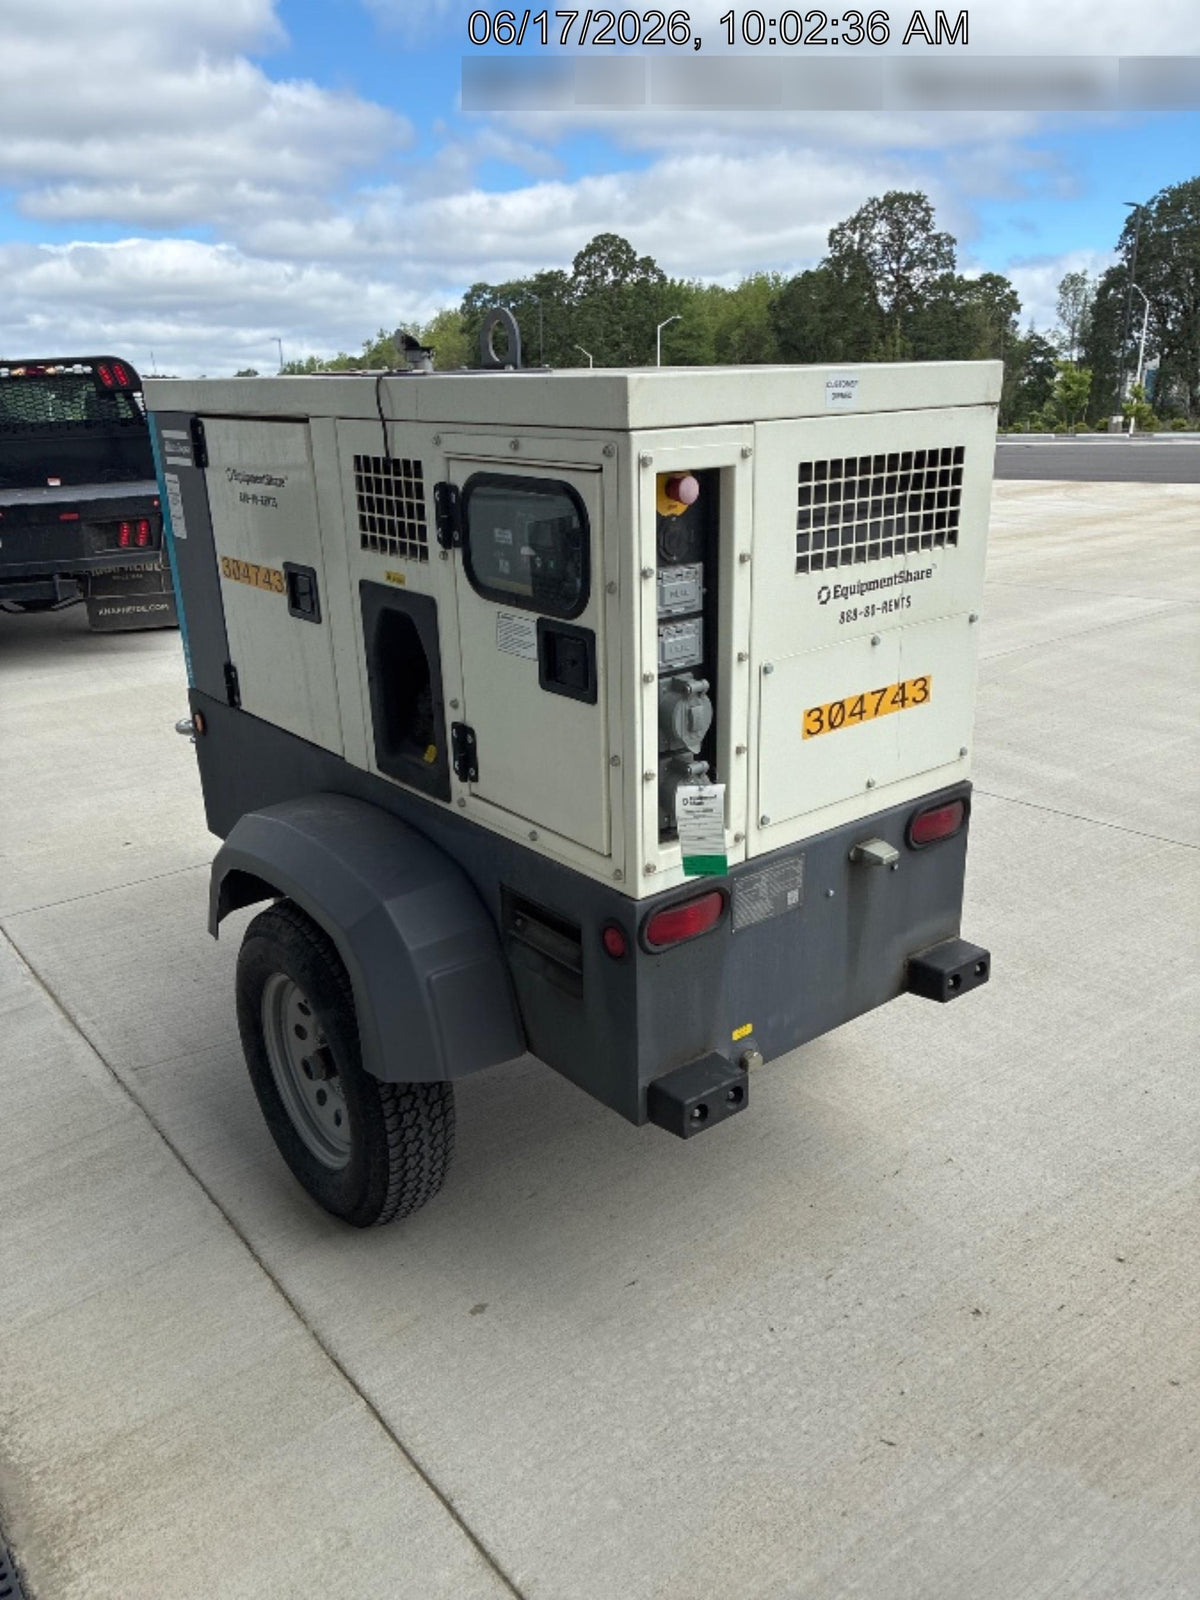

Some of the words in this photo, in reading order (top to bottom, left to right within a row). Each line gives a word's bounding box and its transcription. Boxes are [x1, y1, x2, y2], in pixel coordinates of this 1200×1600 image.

[222, 557, 285, 593] 304743
[833, 568, 933, 599] EquipmentShare
[806, 677, 929, 736] 304743
